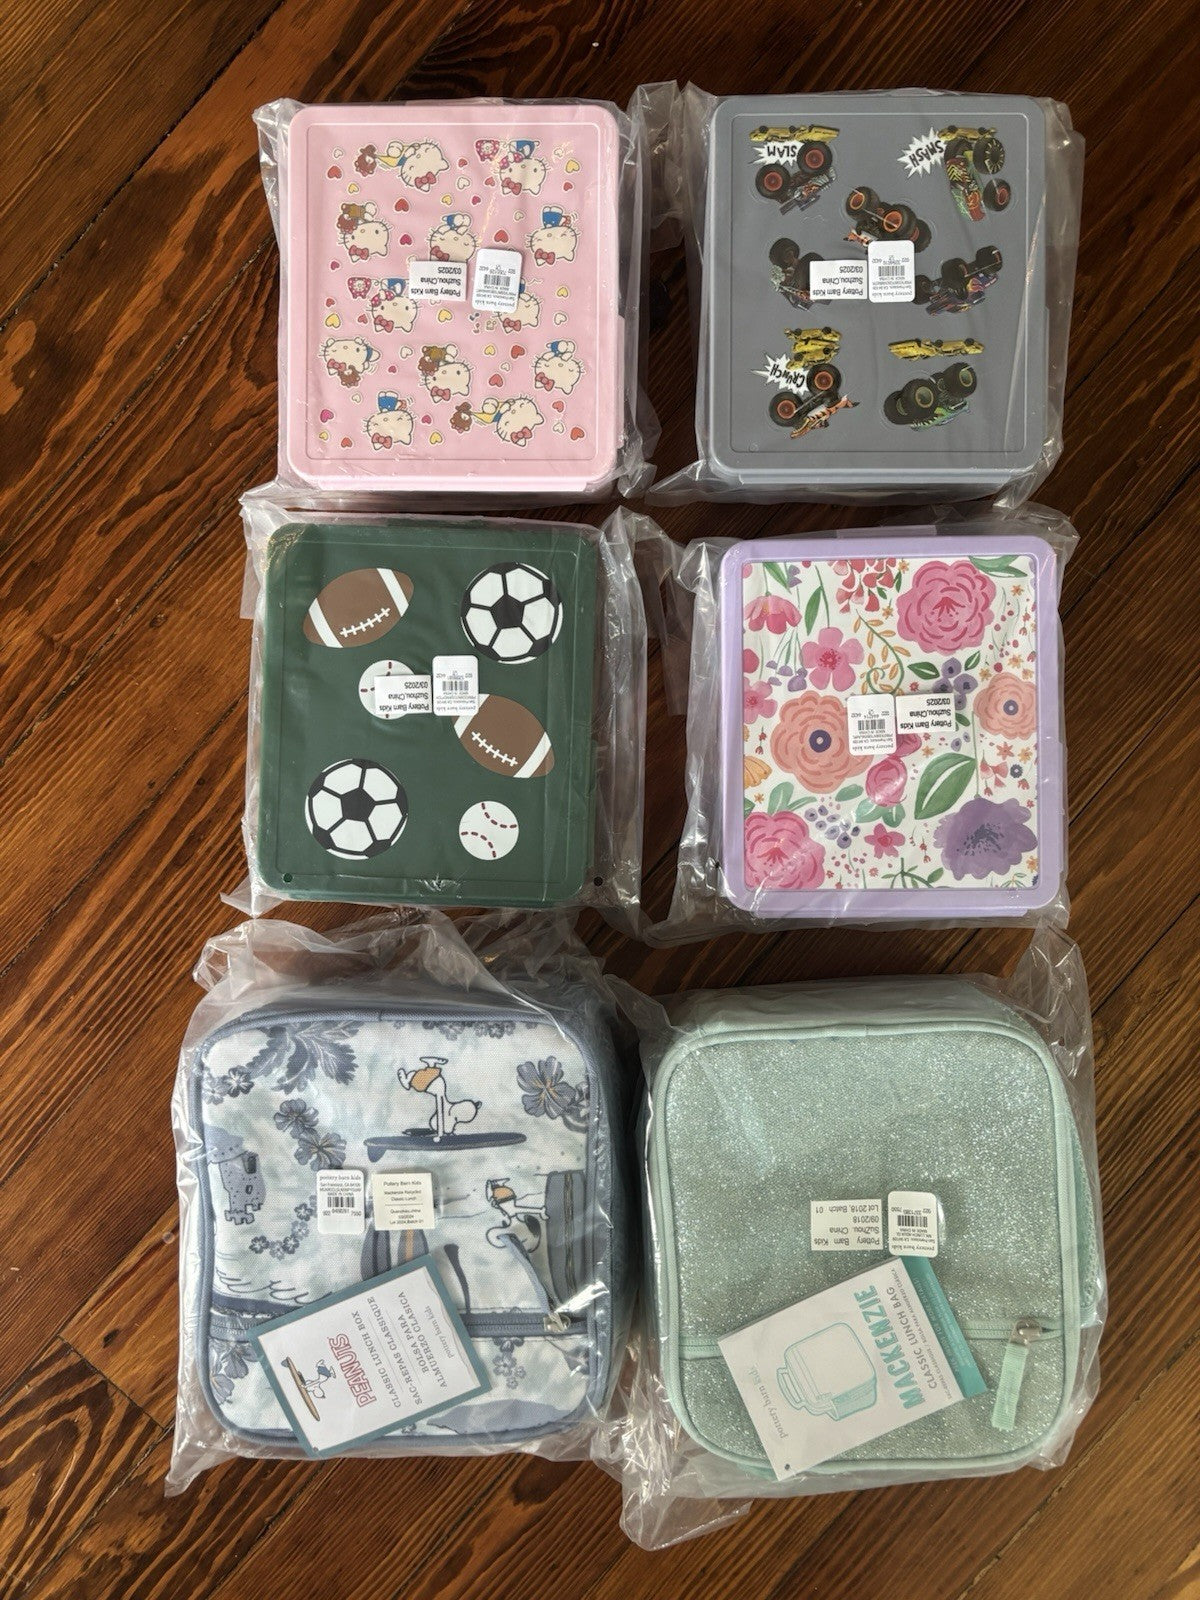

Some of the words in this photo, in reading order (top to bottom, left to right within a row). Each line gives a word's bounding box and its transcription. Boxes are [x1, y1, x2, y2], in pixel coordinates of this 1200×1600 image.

[767, 145, 797, 158] SLAM
[909, 140, 945, 166] SMASH
[437, 266, 461, 274] 03/2025
[839, 265, 862, 273] 03/2025
[439, 287, 460, 297] Pottery
[842, 287, 863, 295] Pottery
[769, 363, 805, 388] CRUNCH
[404, 680, 428, 689] 03/2025
[407, 701, 429, 711] Pottery
[926, 697, 950, 706] 03/2025
[900, 722, 913, 730] Kids
[930, 718, 951, 728] Pottery
[828, 1205, 847, 1213] Batch
[852, 1215, 879, 1223] 09/2018
[829, 1226, 848, 1234] China
[856, 1235, 879, 1245] Pottery
[813, 1237, 828, 1246] Kids
[885, 1285, 901, 1308] BAG
[351, 1309, 366, 1331] BOX
[366, 1294, 398, 1352] CLASSIQUE
[421, 1304, 435, 1320] kids
[396, 1313, 413, 1341] PARA
[895, 1309, 918, 1346] LUNCH
[361, 1331, 382, 1366] LUNCH
[409, 1341, 429, 1373] BOLSA
[437, 1333, 454, 1359] pottery
[853, 1284, 926, 1409] MACKENZIE
[329, 1333, 377, 1407] PEANUTS
[416, 1332, 447, 1390] ALMUERZO
[912, 1346, 938, 1389] CLASSIC
[377, 1365, 402, 1408] CLASSIC
[392, 1350, 423, 1406] SAC-REPAS
[755, 1384, 772, 1407] barn
[766, 1405, 788, 1439] pottery
